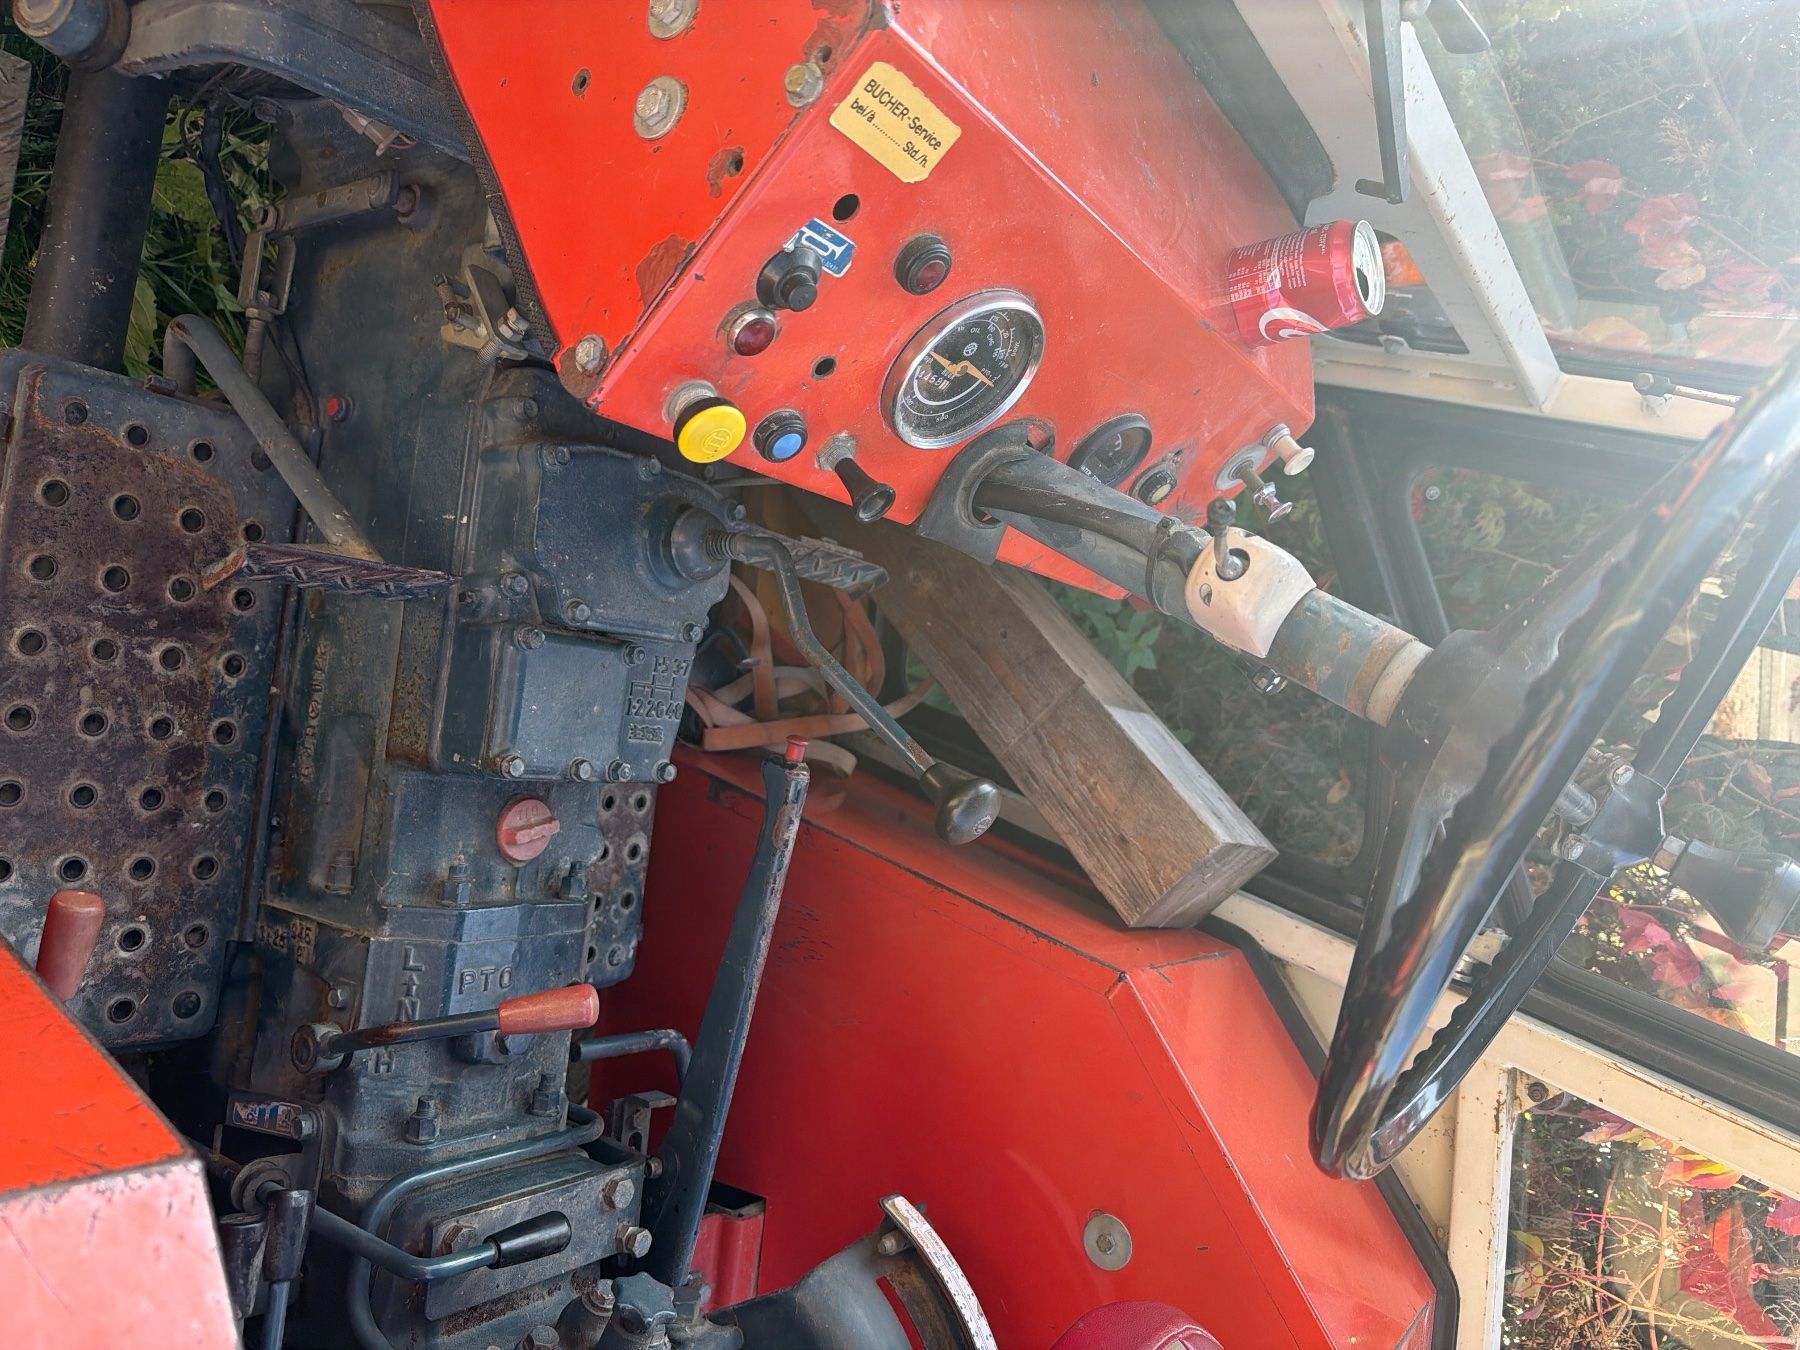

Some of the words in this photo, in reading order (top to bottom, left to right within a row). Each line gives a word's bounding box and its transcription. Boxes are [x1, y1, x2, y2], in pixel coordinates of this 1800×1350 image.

[864, 79, 942, 151] BUCHER-Service
[458, 966, 514, 995] PTO
[927, 1231, 944, 1252] DOWN
